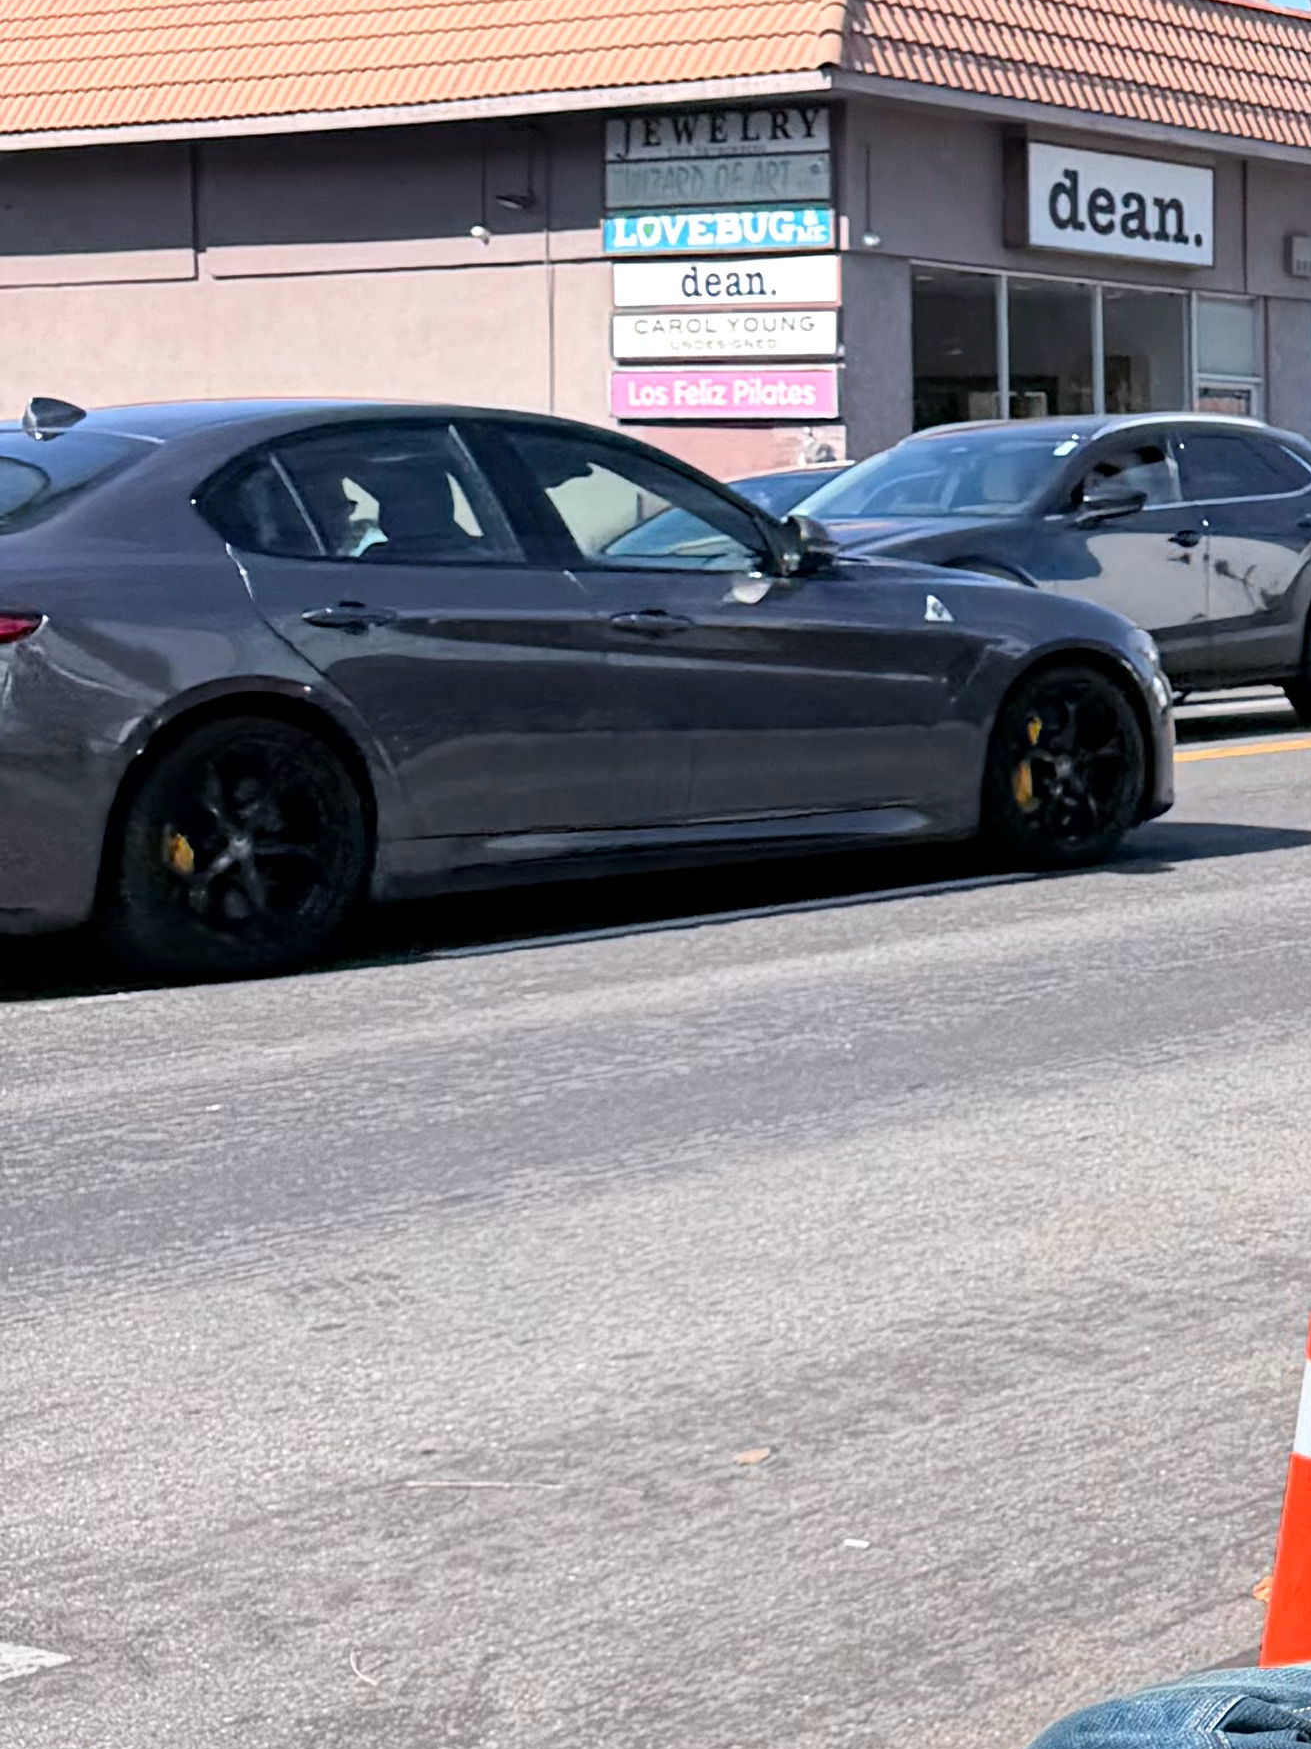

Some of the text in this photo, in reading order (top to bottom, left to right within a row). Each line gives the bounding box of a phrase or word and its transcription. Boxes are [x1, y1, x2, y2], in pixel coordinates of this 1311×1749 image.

[615, 107, 821, 162] JEWELRY
[1048, 168, 1203, 248] dean.
[613, 210, 795, 249] LOVEBUG
[681, 265, 777, 298] dean.
[634, 316, 815, 335] CAROL YOUNG
[628, 379, 817, 406] Los Feliz Pilates
